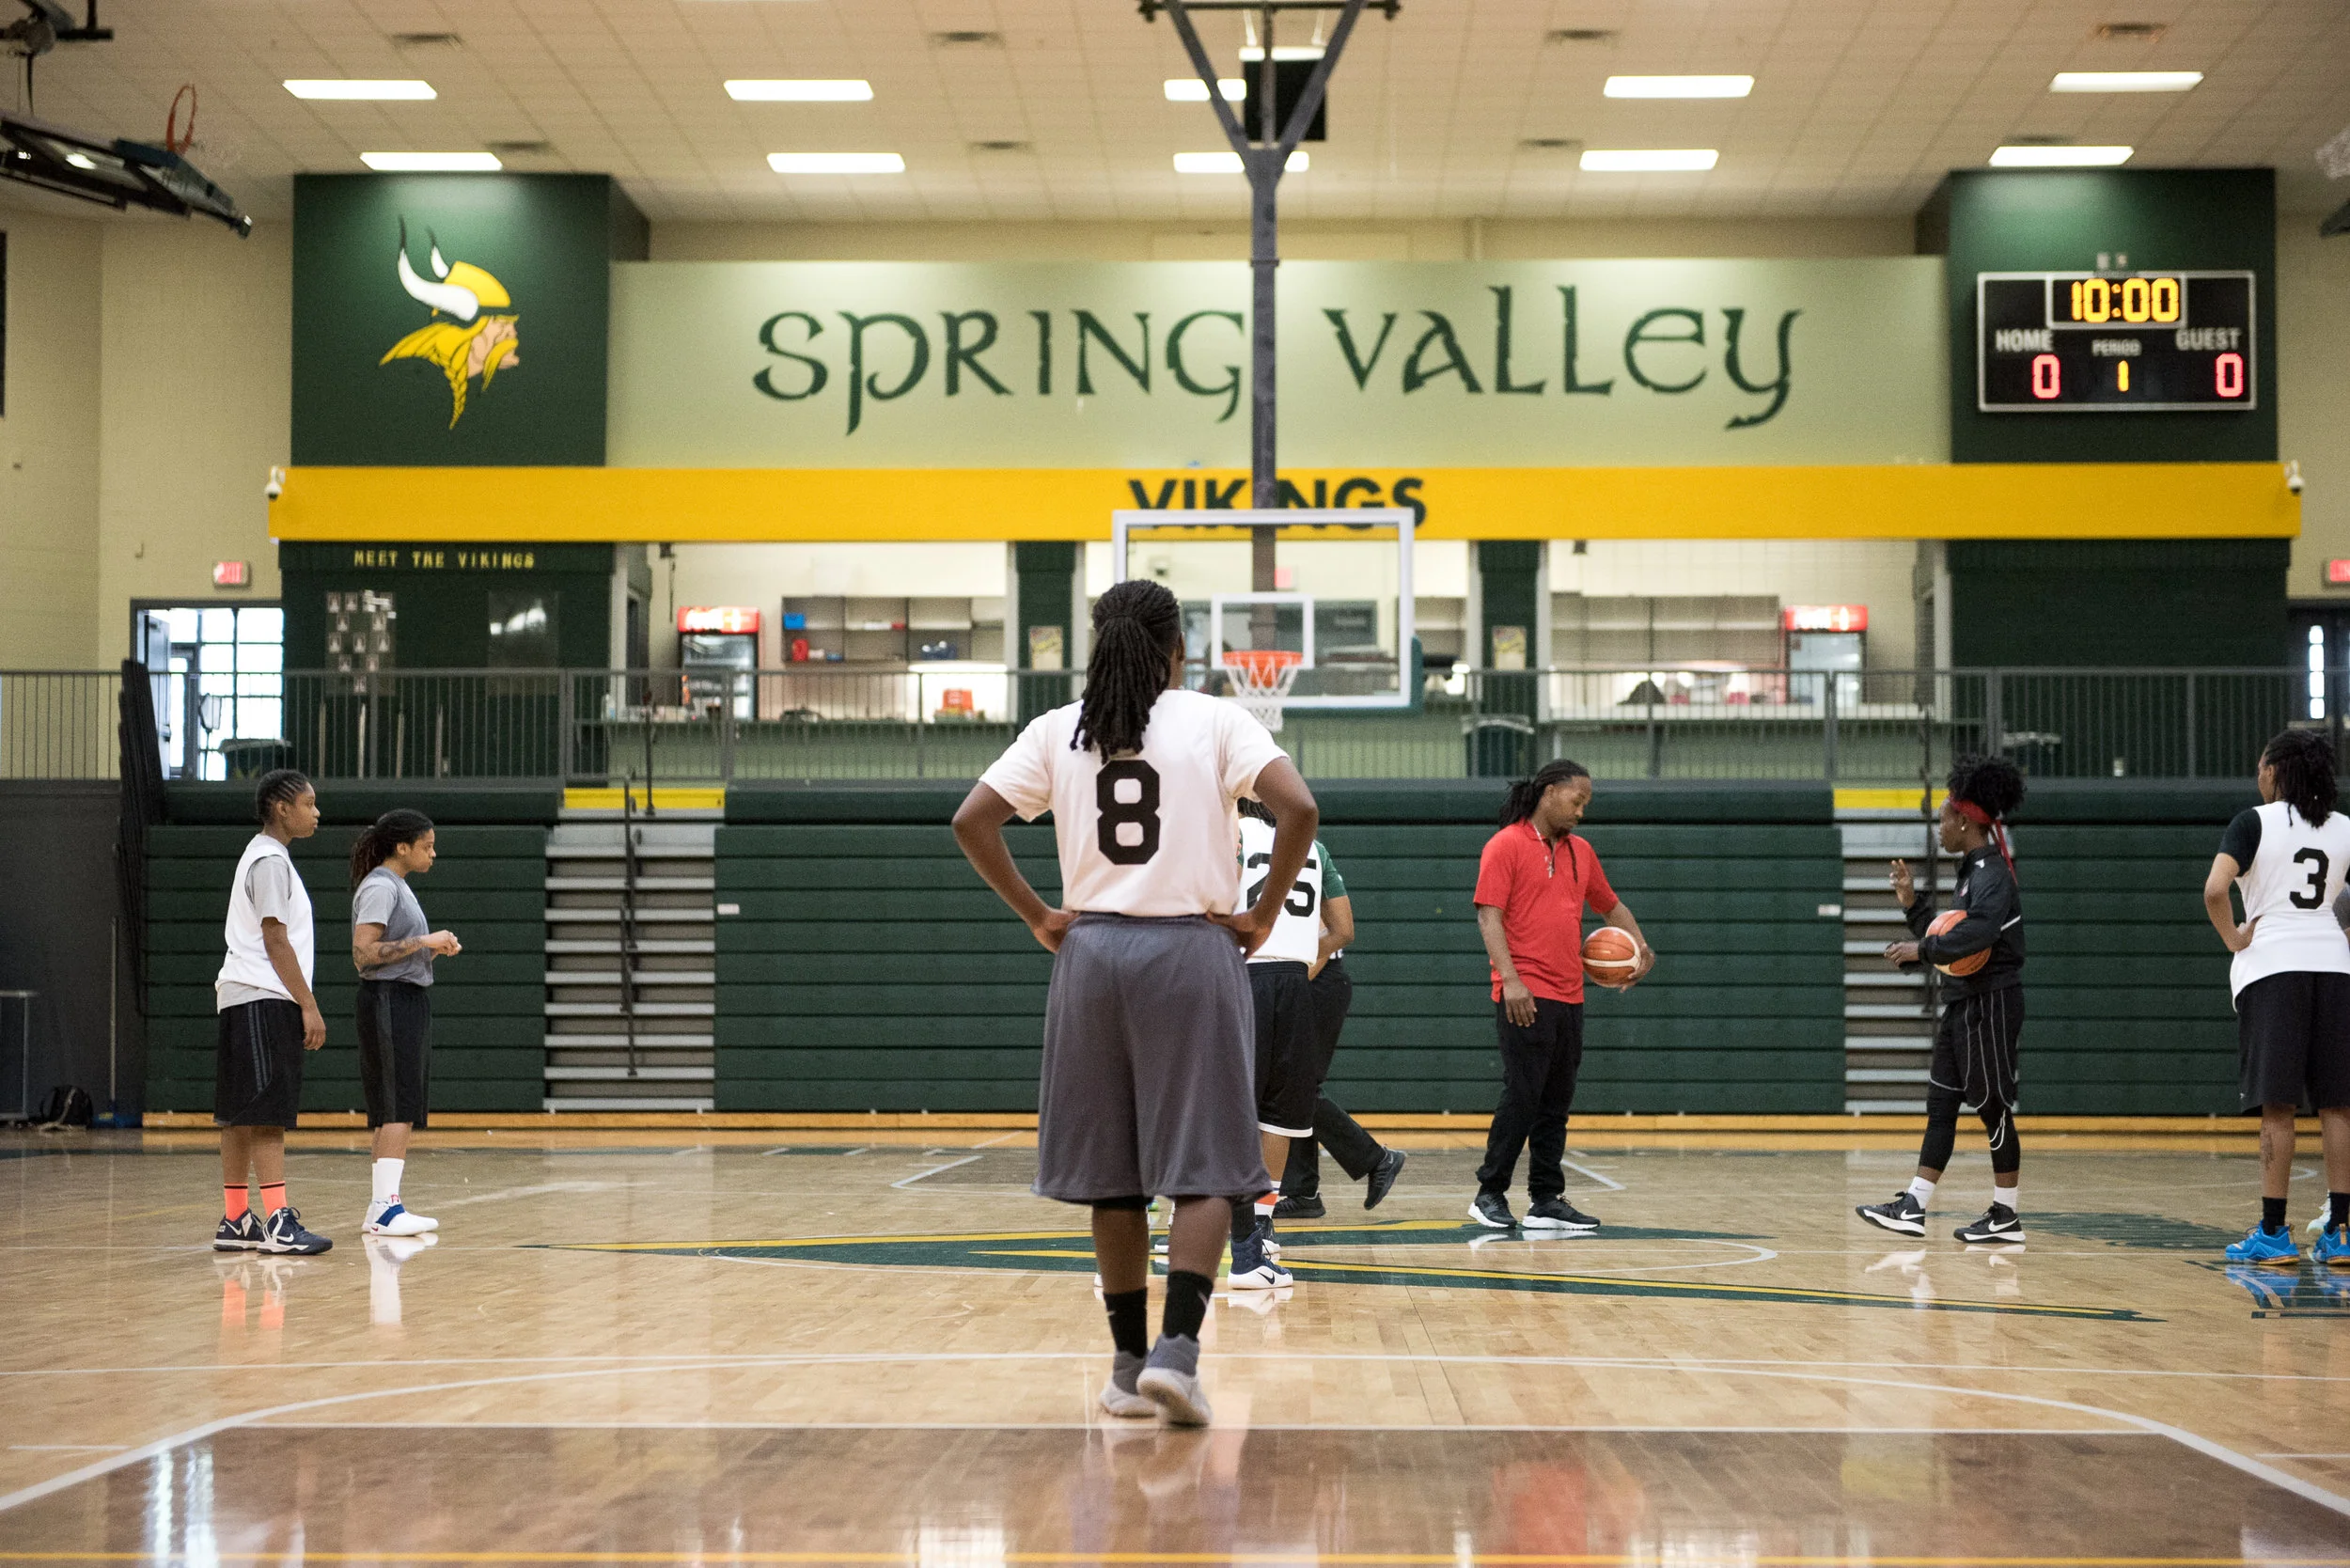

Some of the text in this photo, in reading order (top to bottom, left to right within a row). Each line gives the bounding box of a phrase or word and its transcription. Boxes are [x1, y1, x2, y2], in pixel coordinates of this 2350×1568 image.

[2071, 278, 2179, 322] 10:00
[1995, 330, 2054, 353] HOME
[2092, 339, 2141, 356] PERIOD
[2175, 328, 2241, 351] GUEST
[2032, 353, 2060, 399] 0
[2118, 360, 2129, 392] 1
[2216, 353, 2243, 398] 0
[1128, 478, 1426, 529] VIKNGS
[354, 550, 535, 570] MEET THE VIKINGS
[1097, 760, 1160, 865] 8
[2290, 847, 2329, 909] 3
